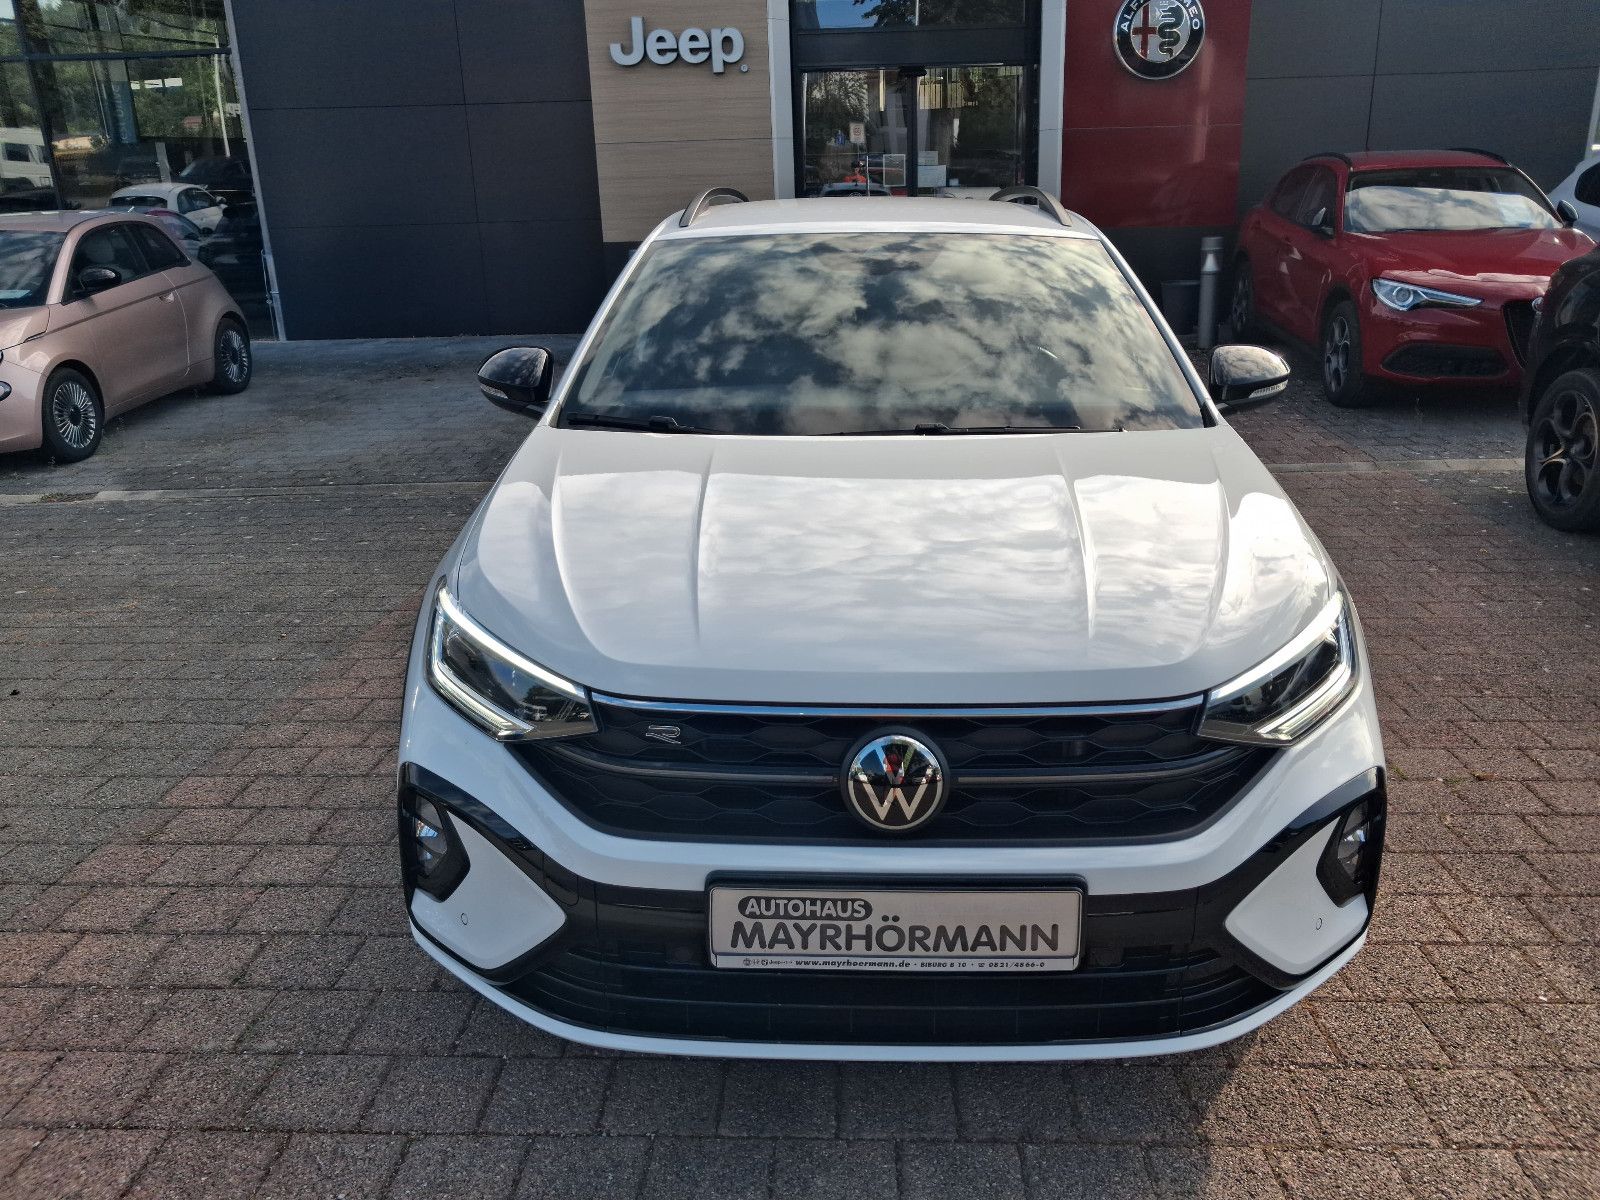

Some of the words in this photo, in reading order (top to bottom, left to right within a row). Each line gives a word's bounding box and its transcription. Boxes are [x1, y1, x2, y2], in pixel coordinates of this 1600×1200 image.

[1120, 0, 1143, 32] ALF
[609, 16, 745, 74] Jeep
[744, 897, 867, 918] AUTOHAUS
[730, 914, 1060, 953] MAYRHÖRMANN
[795, 958, 911, 968] www.mayrhoermann.de
